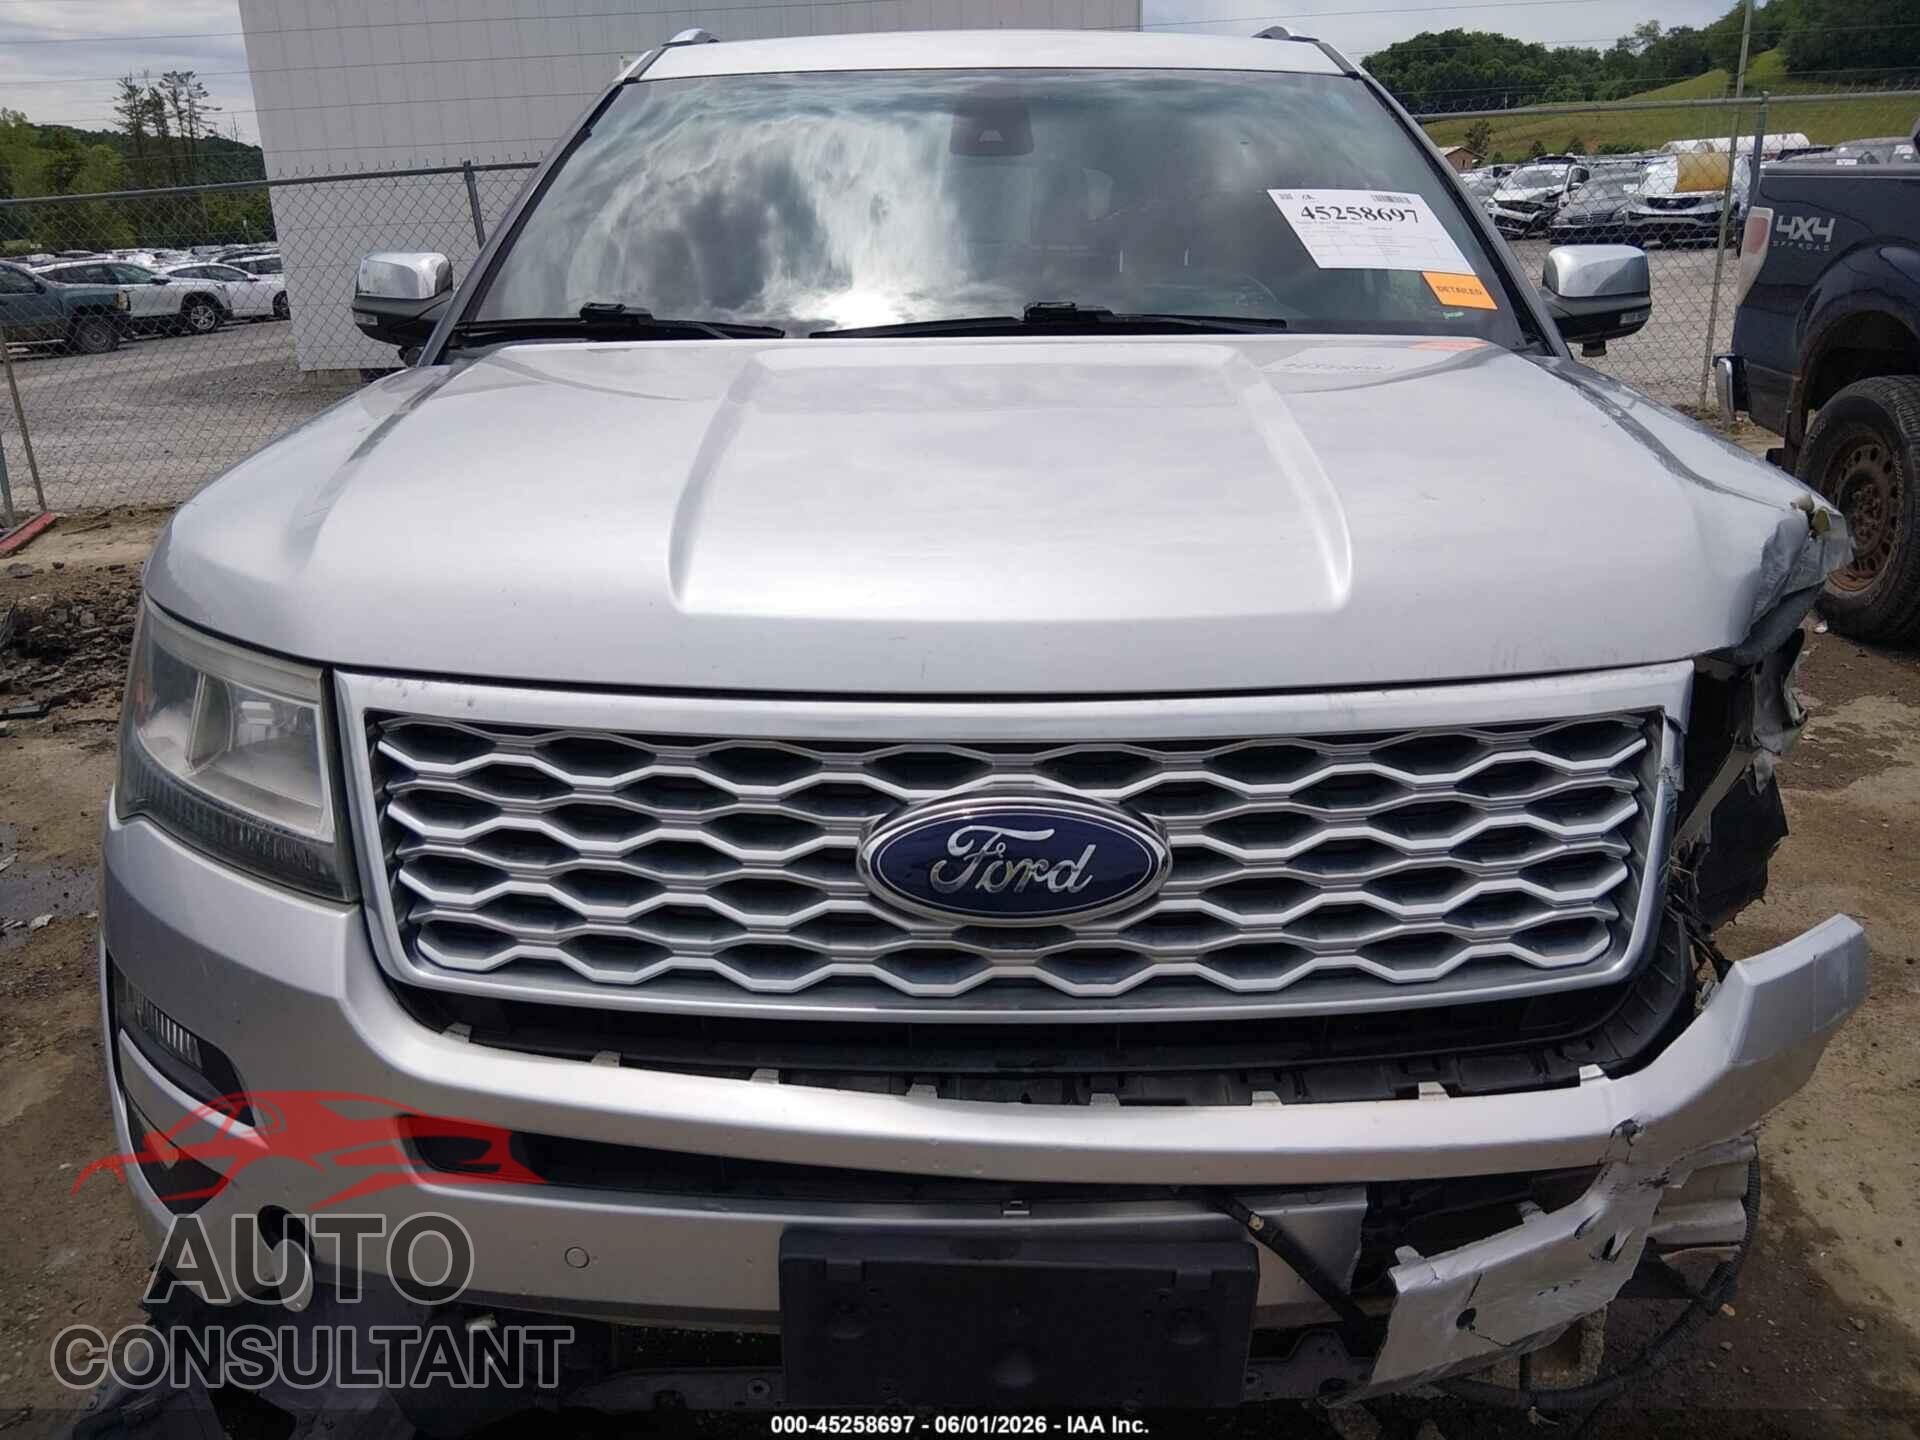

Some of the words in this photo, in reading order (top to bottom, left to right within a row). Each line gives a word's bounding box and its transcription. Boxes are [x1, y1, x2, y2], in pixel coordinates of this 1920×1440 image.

[1300, 205, 1419, 223] 45258697
[1435, 285, 1483, 296] DETAILED
[930, 825, 1096, 893] Ford
